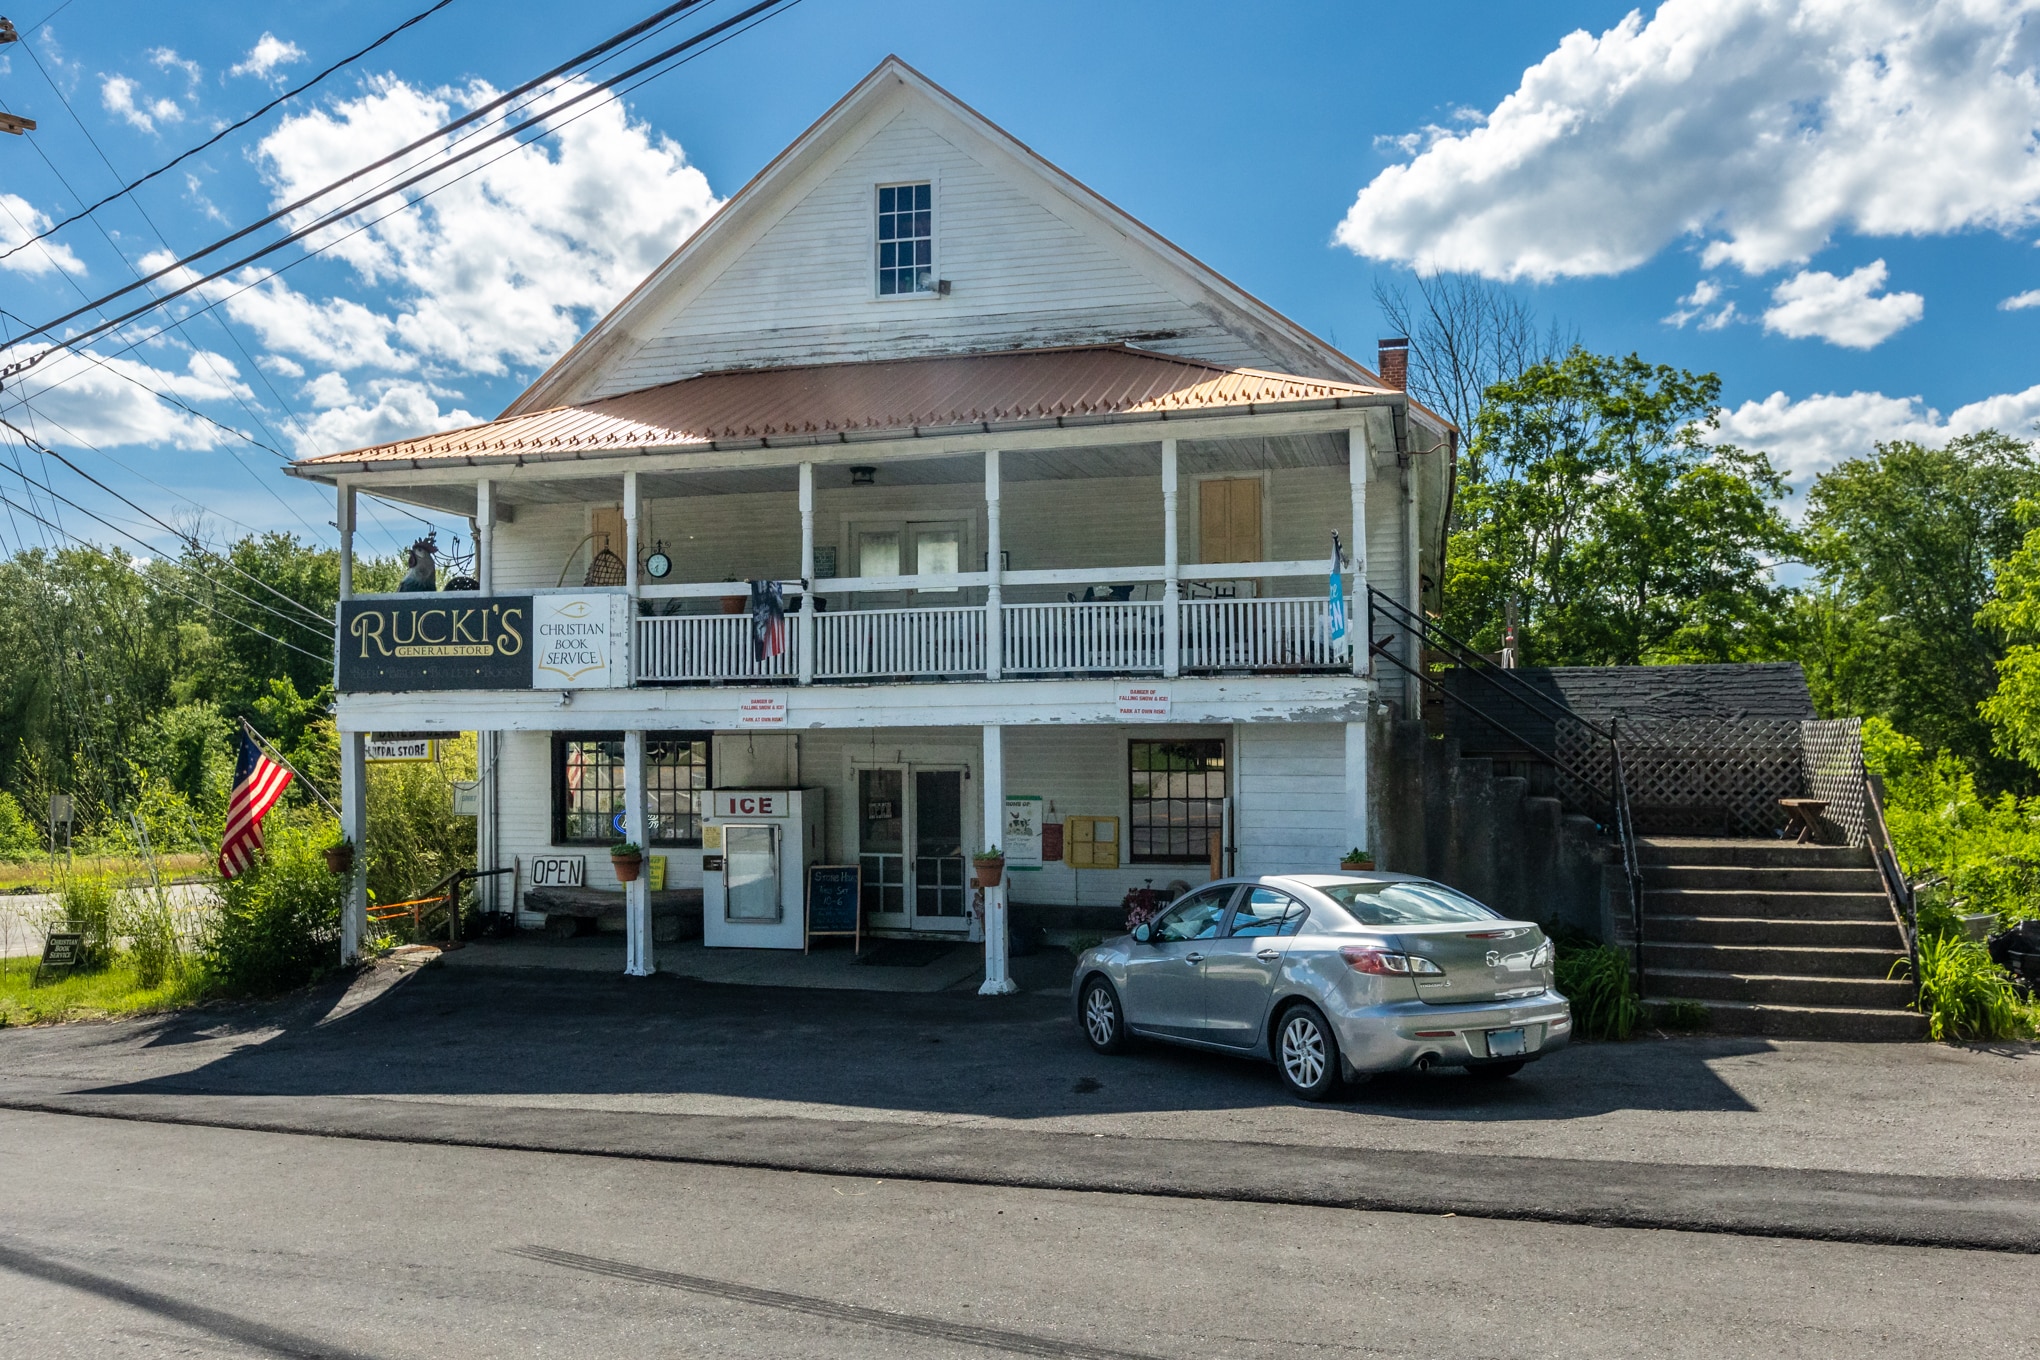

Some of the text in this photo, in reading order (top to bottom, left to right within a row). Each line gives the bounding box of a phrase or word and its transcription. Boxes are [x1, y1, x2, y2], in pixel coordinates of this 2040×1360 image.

[350, 603, 524, 659] RUCKI'S
[539, 623, 604, 636] CHRISTIAN
[554, 638, 588, 649] BOOK
[398, 645, 490, 656] GENERAL STORE
[546, 651, 598, 665] SERVICE
[398, 743, 426, 757] STORE
[729, 797, 773, 814] ICE
[533, 859, 581, 885] OPEN
[50, 938, 79, 946] CHRISTIAN
[49, 951, 71, 959] SERVICE
